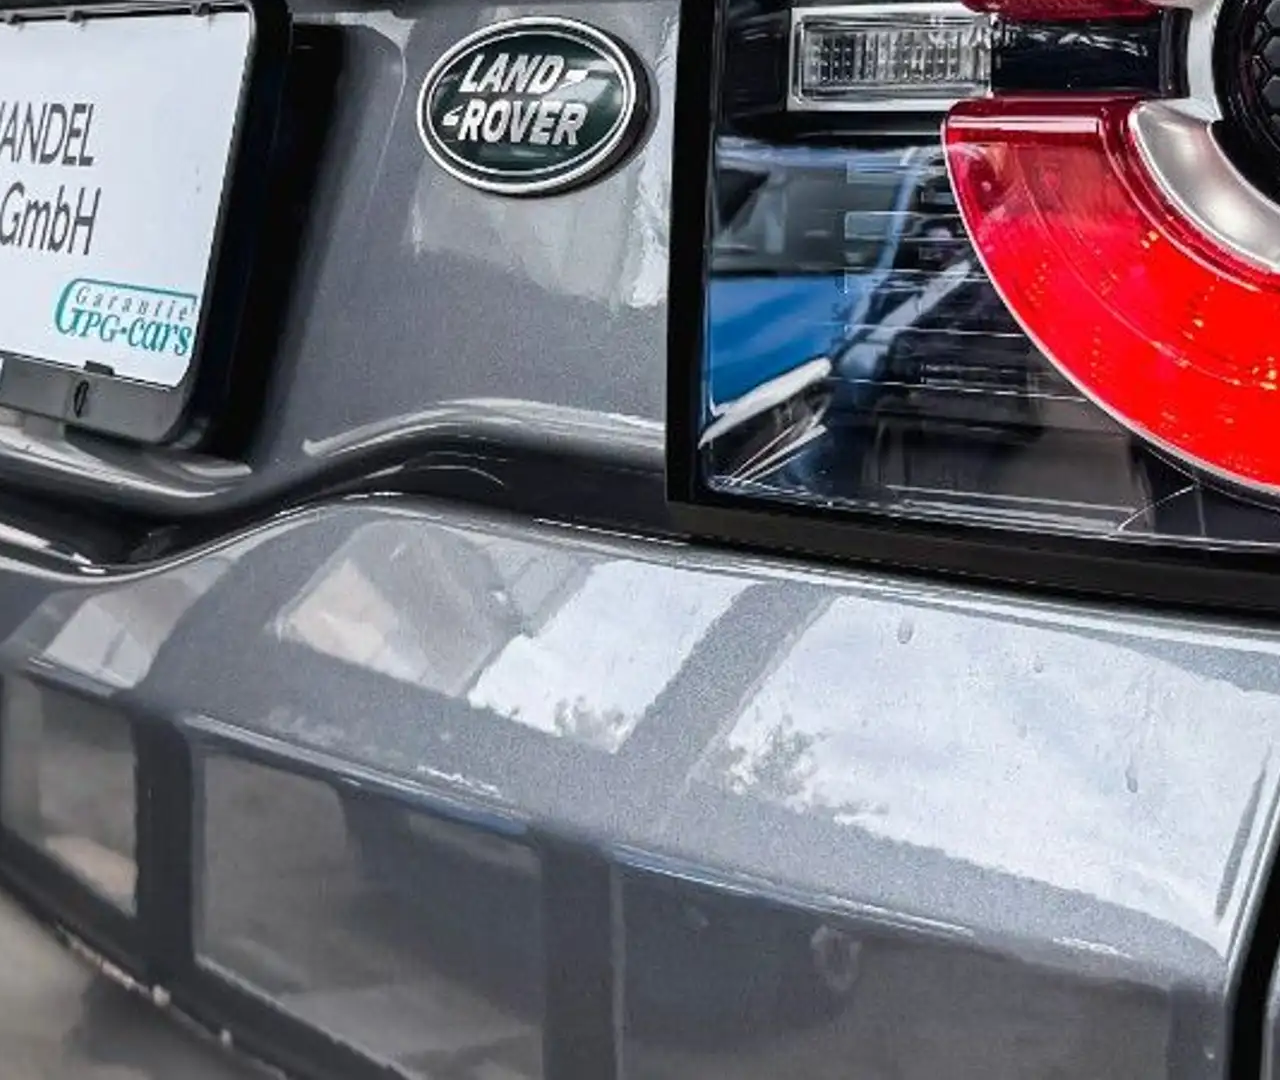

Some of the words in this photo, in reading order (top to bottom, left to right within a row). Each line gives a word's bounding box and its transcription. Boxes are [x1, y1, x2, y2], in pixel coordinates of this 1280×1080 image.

[459, 52, 565, 95] LAND
[456, 98, 589, 146] ROVER
[75, 286, 190, 321] Garantie
